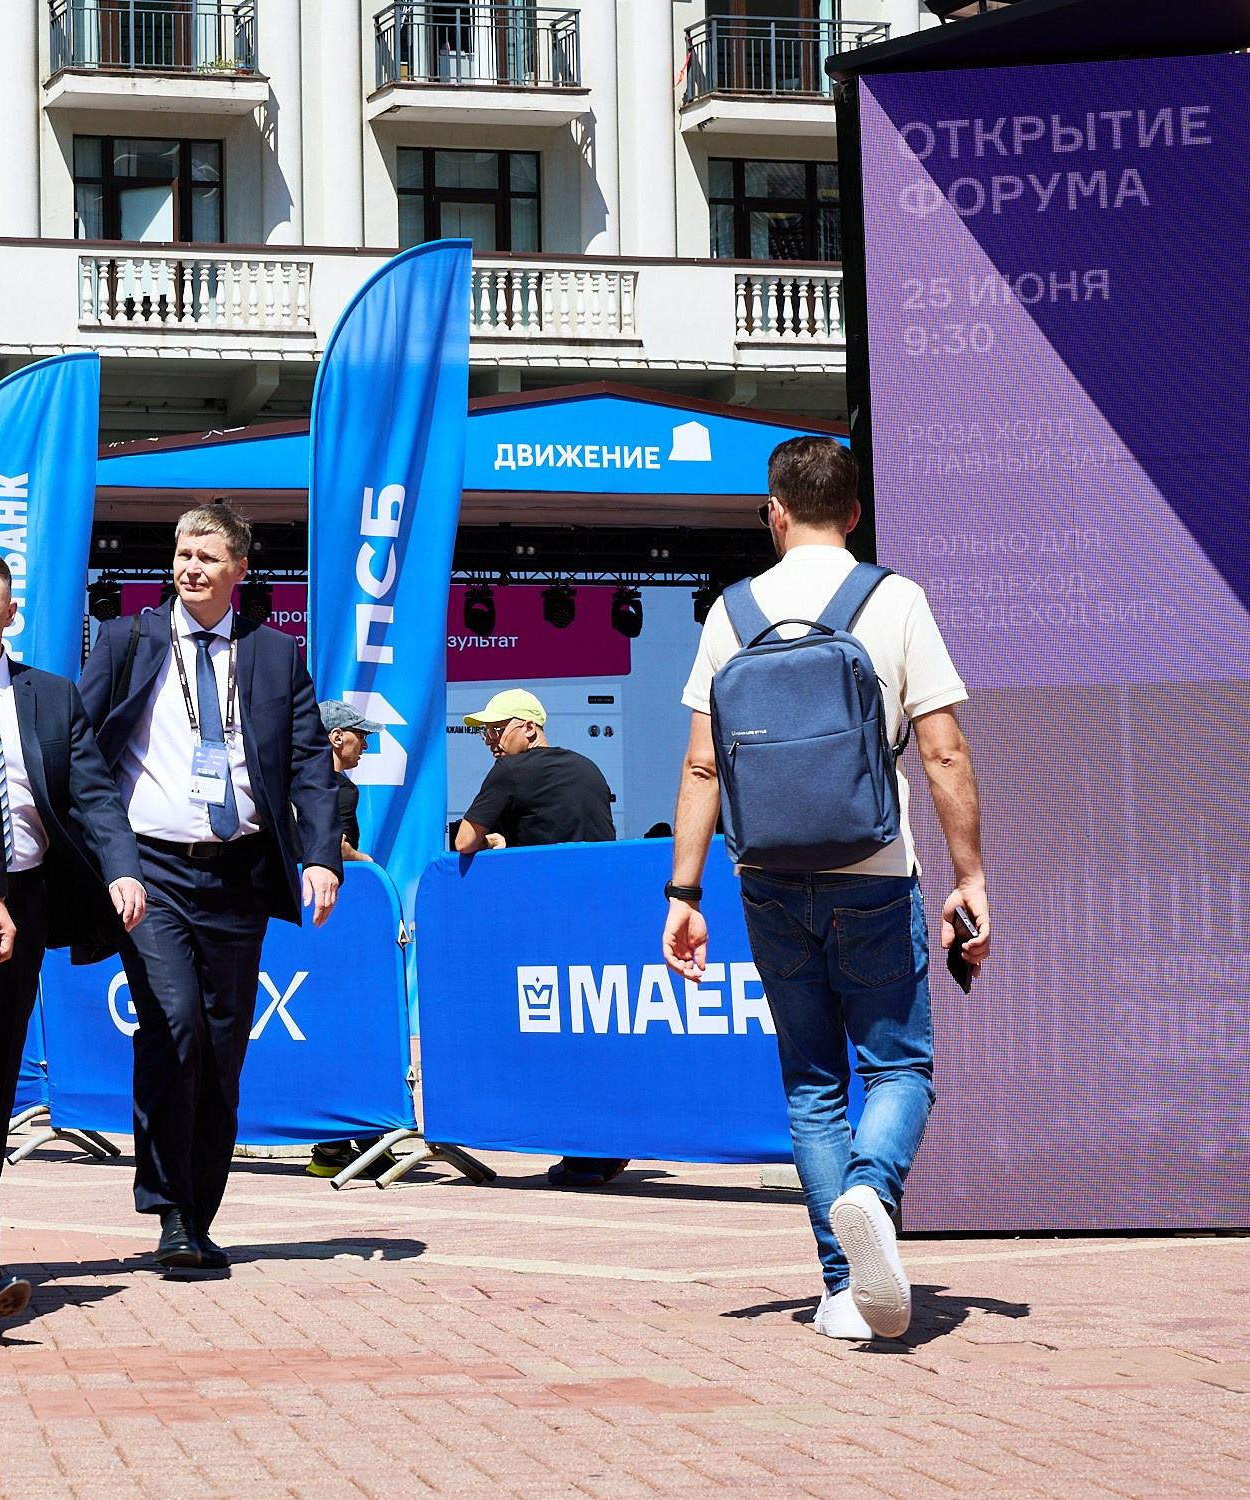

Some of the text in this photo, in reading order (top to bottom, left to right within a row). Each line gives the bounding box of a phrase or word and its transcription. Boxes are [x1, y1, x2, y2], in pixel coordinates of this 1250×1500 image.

[900, 104, 1213, 162] ОТКРЫТИЕ
[900, 167, 1151, 217] ФОРУМА
[902, 268, 1111, 310] 25 ИЮНЯ
[903, 321, 994, 357] 9:30
[494, 443, 661, 471] ДВИЖЕНИЕ
[355, 483, 406, 664] ПСБ
[447, 635, 519, 651] зультат
[568, 962, 778, 1035] MAER
